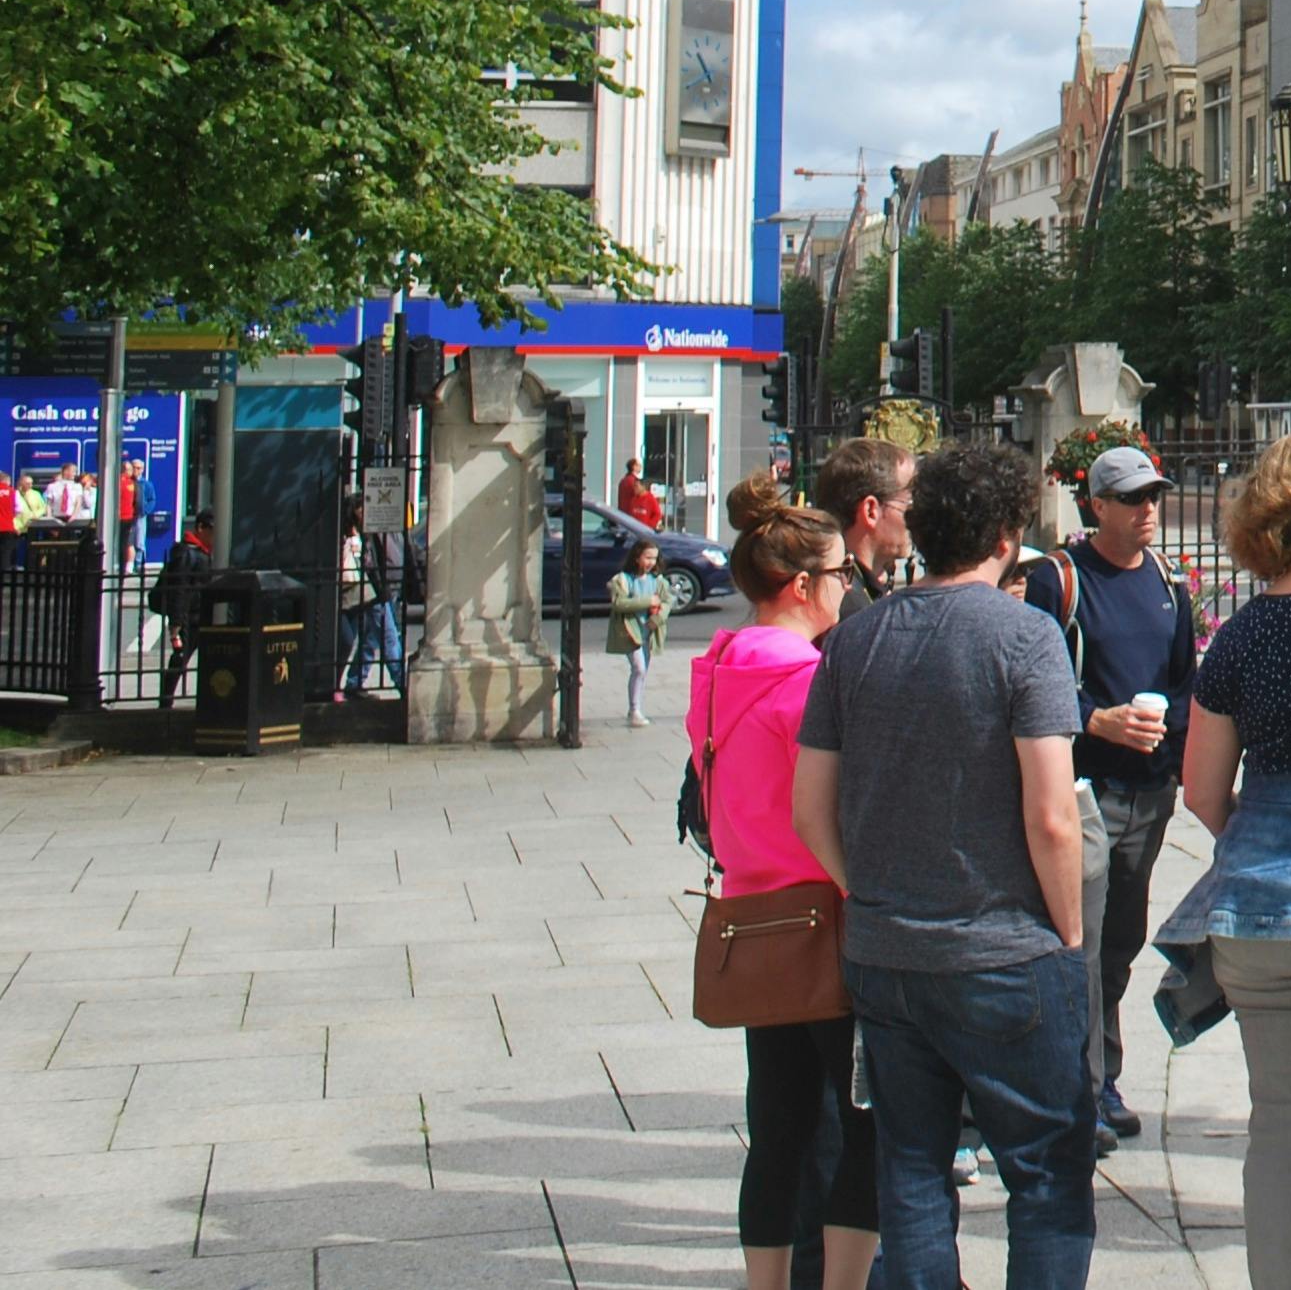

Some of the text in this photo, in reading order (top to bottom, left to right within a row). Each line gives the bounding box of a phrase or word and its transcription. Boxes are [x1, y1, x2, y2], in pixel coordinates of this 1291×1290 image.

[663, 327, 730, 348] Nationwide
[12, 404, 59, 421] Cash
[63, 407, 87, 420] on
[126, 405, 150, 423] go
[266, 641, 299, 654] LITTER
